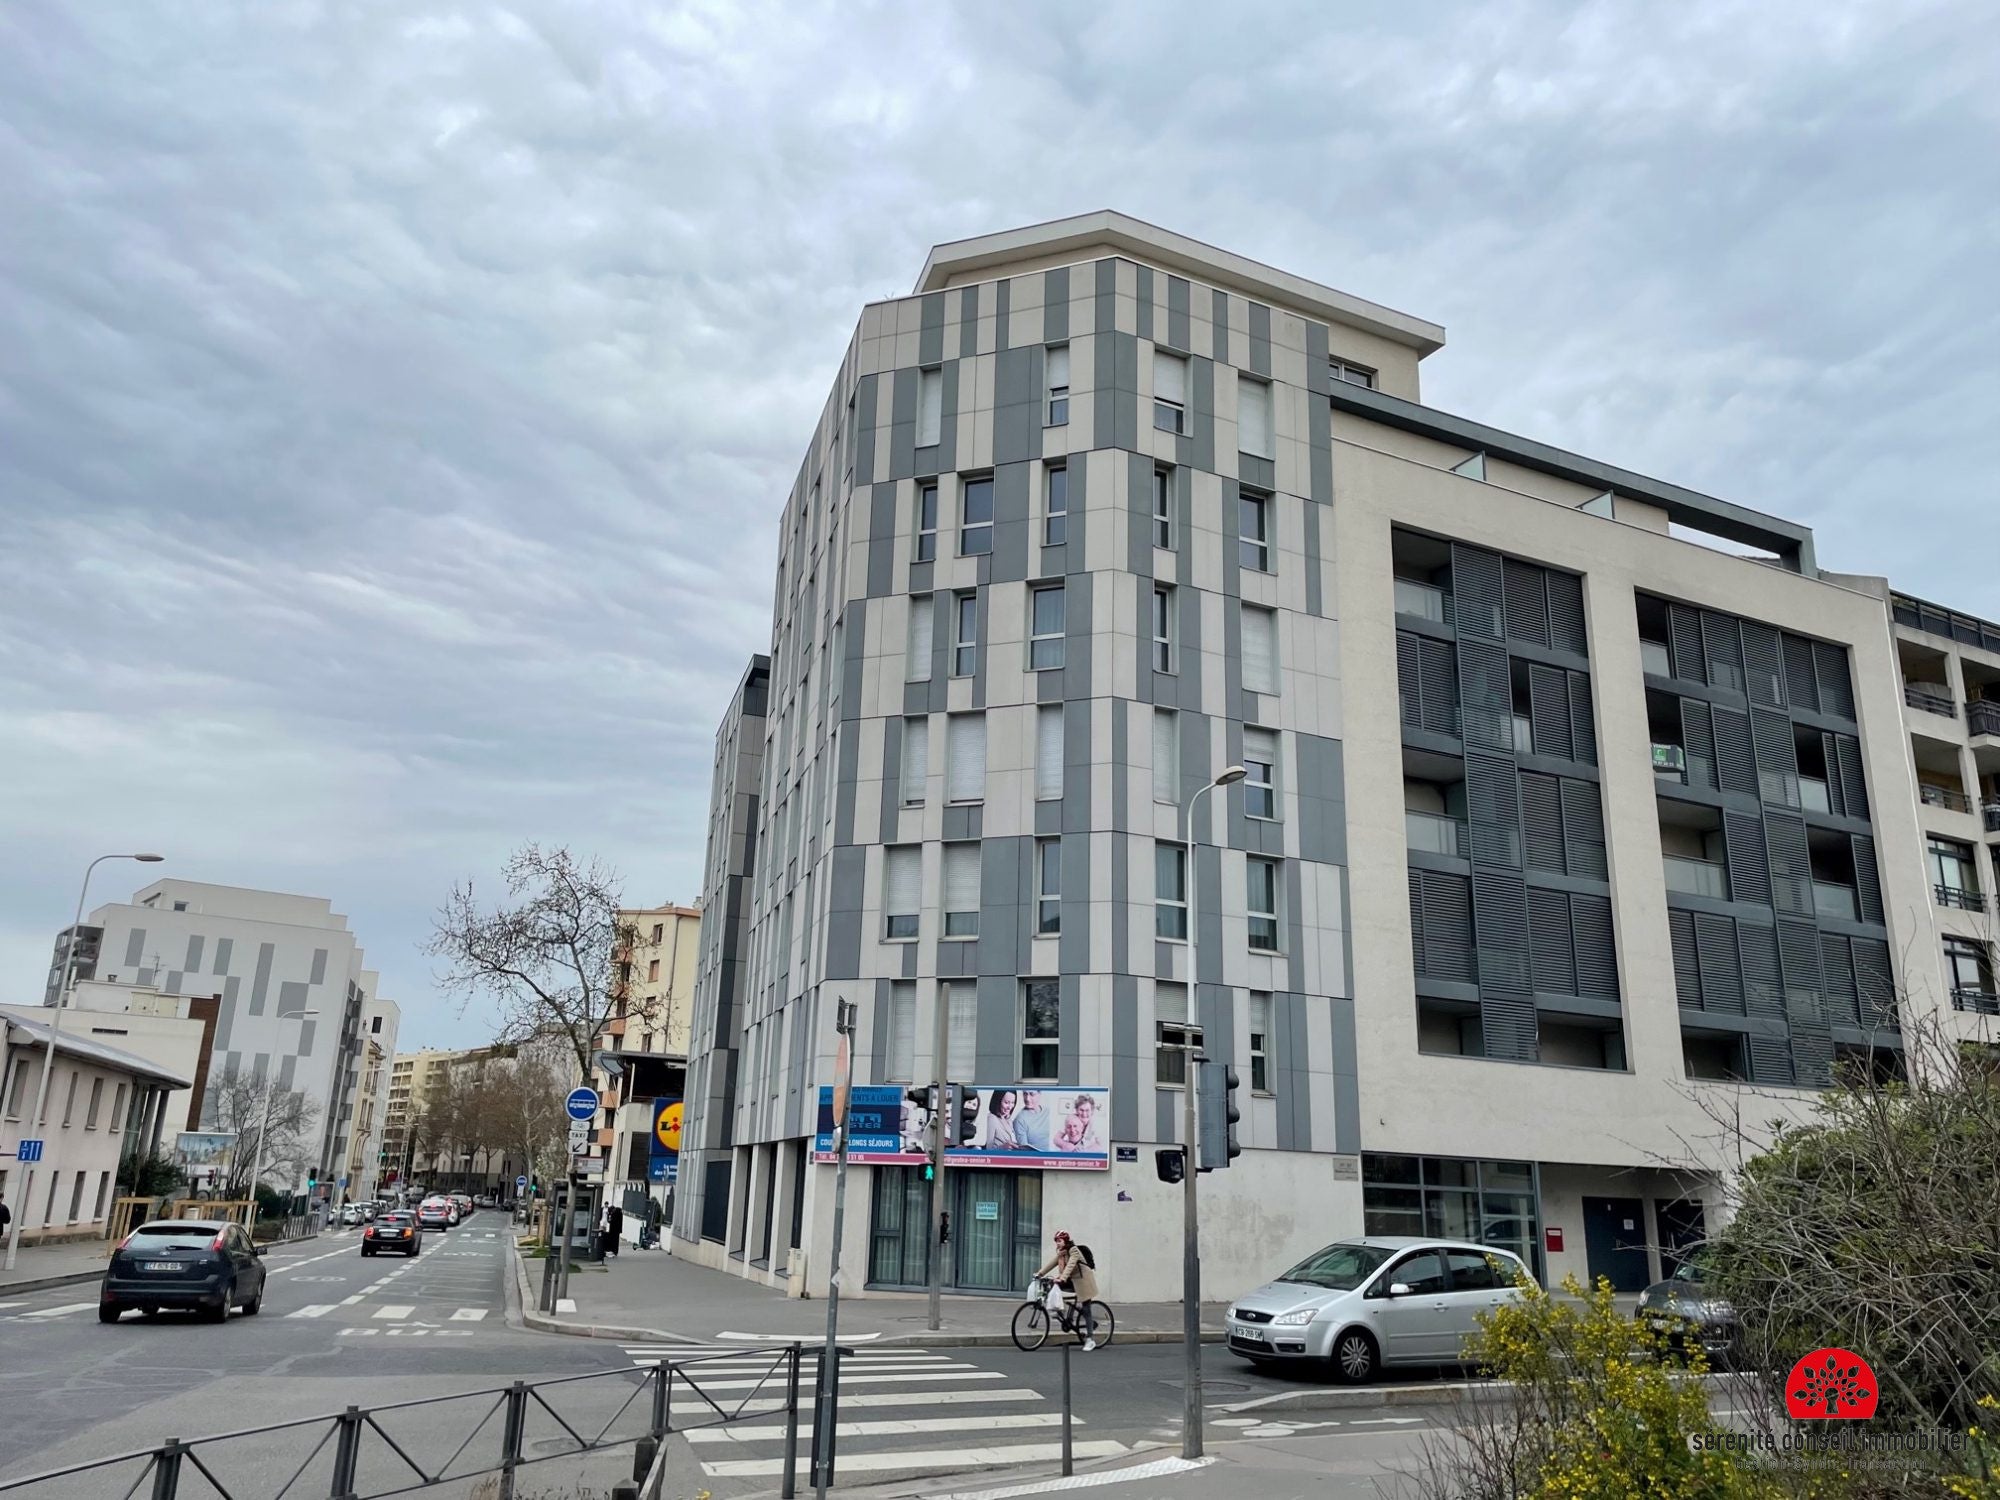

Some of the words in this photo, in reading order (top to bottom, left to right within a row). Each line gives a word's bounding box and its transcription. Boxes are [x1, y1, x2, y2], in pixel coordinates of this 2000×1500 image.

[848, 1139, 867, 1147] LONGS
[868, 1137, 894, 1148] SÉJOURS
[336, 1328, 474, 1336] BUS
